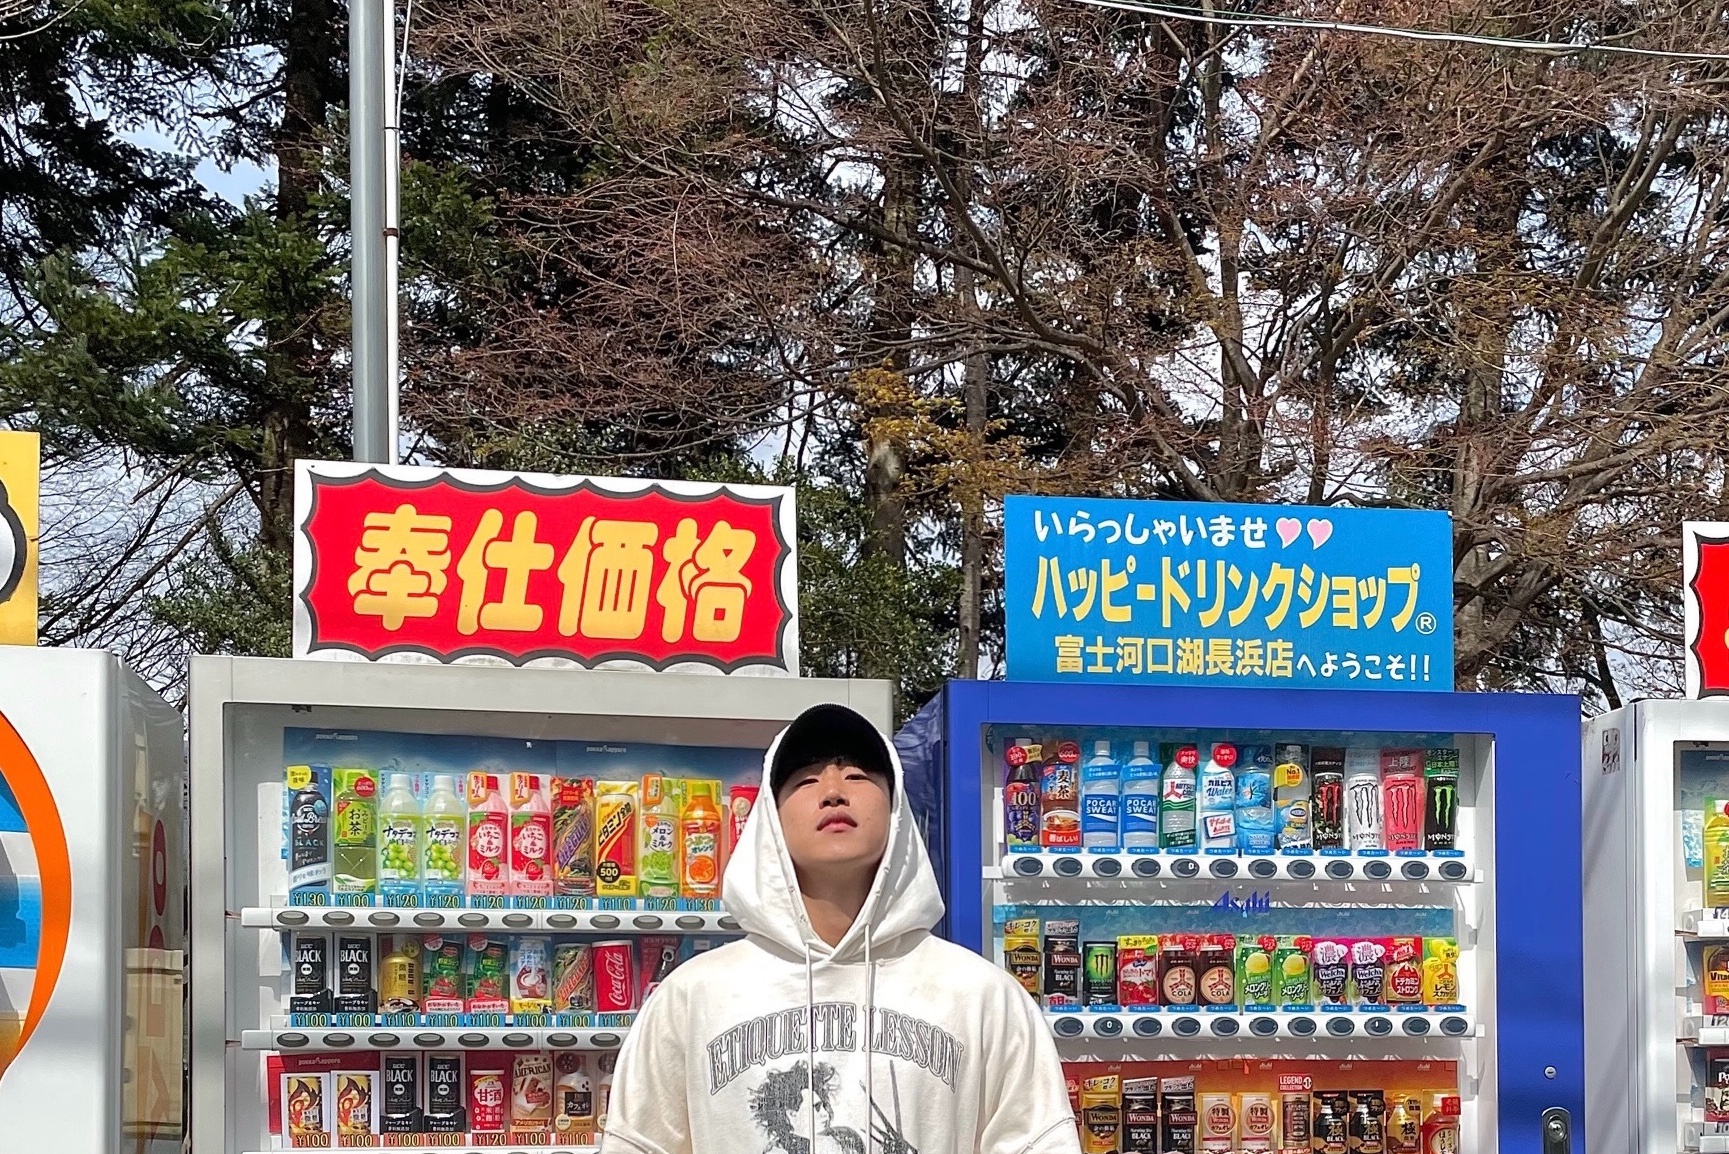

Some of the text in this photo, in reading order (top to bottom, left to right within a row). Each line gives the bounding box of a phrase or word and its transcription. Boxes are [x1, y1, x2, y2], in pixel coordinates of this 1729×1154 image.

[1034, 509, 1268, 548] いらっしゃいませ
[347, 504, 755, 644] 奉仕価格
[1057, 769, 1070, 798] 麦茶
[1207, 787, 1232, 797] Water
[1011, 792, 1037, 805] 100
[349, 808, 362, 836] お茶
[652, 827, 674, 836] メロン
[651, 840, 673, 849] ミルク
[600, 868, 619, 877] 500
[295, 950, 322, 962] BLACK
[340, 950, 368, 962] BLACK
[1015, 953, 1039, 962] WONDA
[1053, 955, 1078, 963] WONDA
[706, 1002, 964, 1096] ETIQUETTE LESSON
[386, 1069, 413, 1082] BLACK
[430, 1069, 458, 1082] BLACK
[513, 1062, 551, 1078] AMERICAN
[1280, 1076, 1302, 1084] LEGEND
[477, 1088, 503, 1102] 甘酒
[1091, 1112, 1117, 1121] WONDA
[1129, 1113, 1154, 1121] WONDA
[1212, 1107, 1229, 1116] 特製
[1250, 1107, 1268, 1116] 特製
[1170, 1114, 1195, 1122] WONDA
[1401, 1122, 1416, 1135] 極
